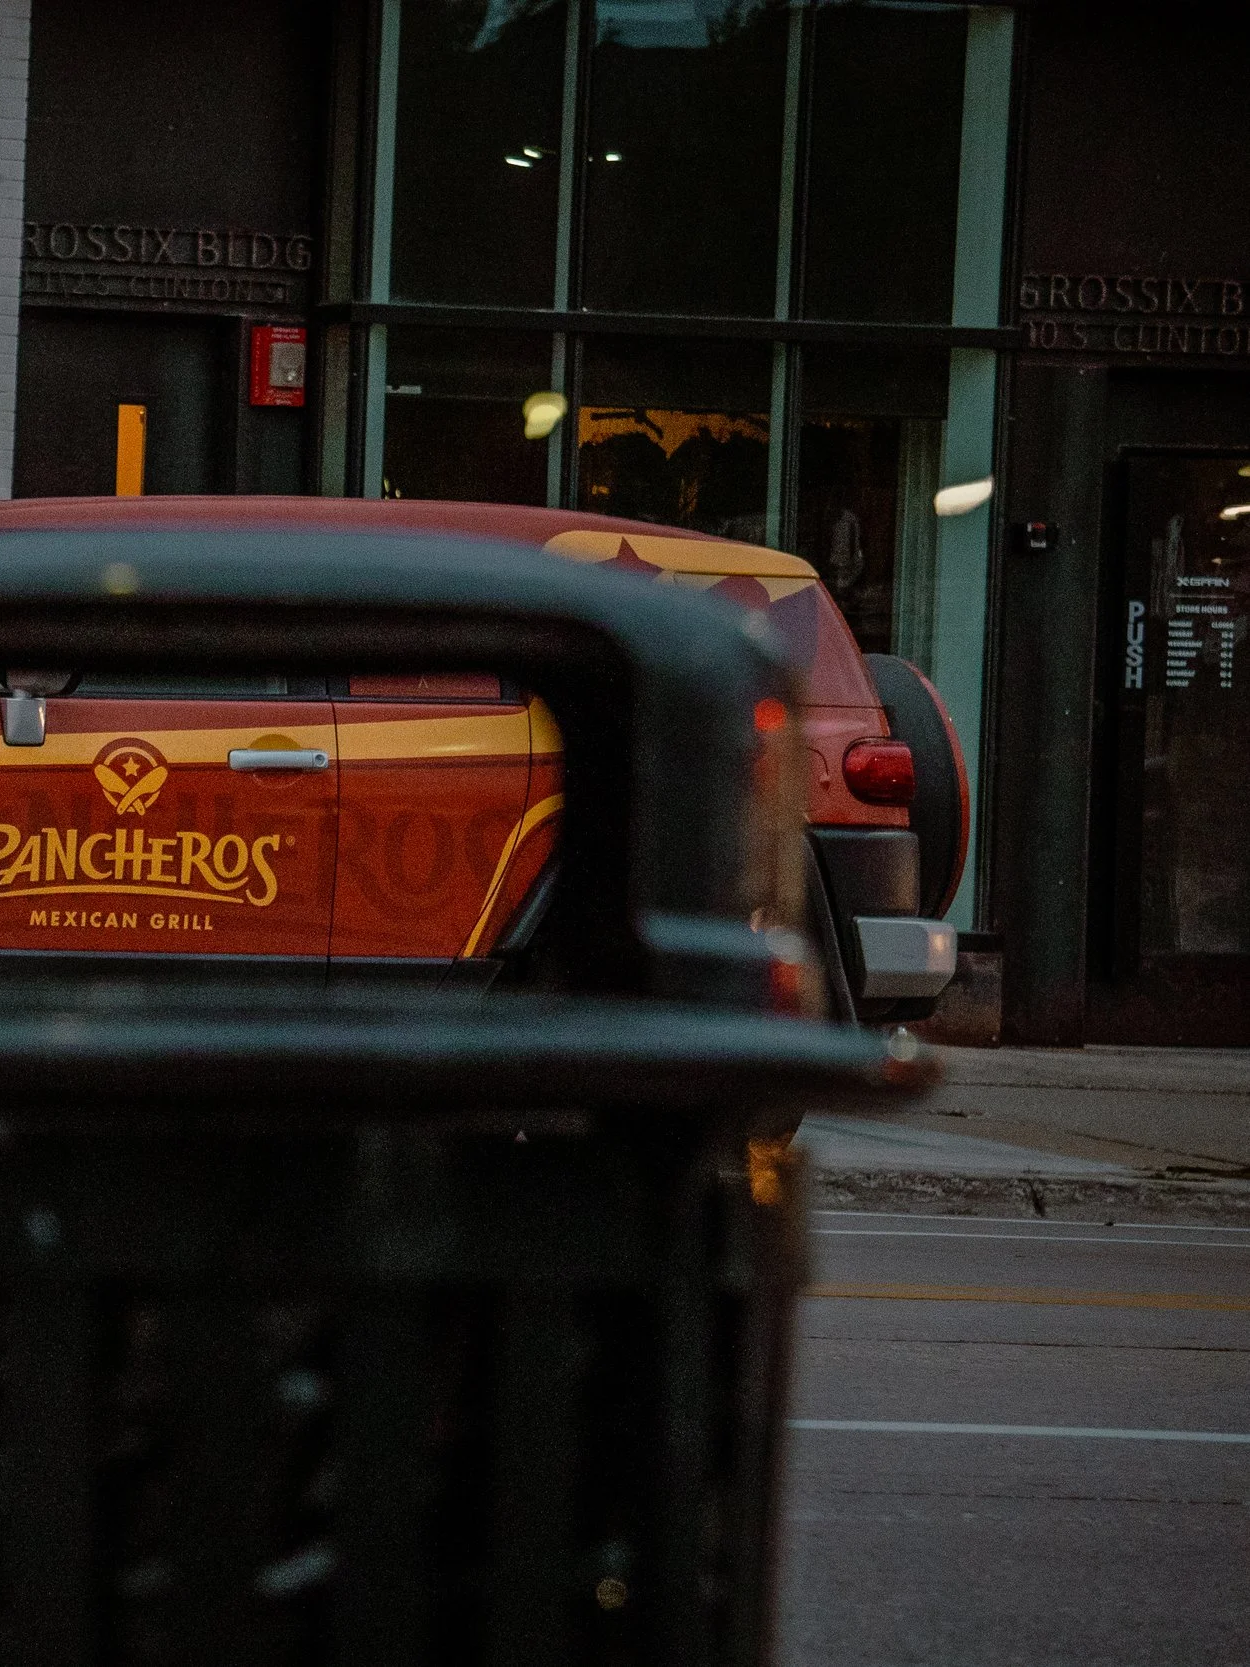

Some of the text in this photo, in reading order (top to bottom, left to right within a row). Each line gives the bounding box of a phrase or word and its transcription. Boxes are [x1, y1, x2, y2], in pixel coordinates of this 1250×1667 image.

[197, 229, 313, 271] BLDG
[1019, 273, 1201, 313] GROSSIX
[1113, 323, 1250, 355] CLINTO
[1201, 604, 1229, 615] HOURS
[1125, 600, 1146, 690] PUSH
[29, 910, 214, 931] MEXICAN GRILL
